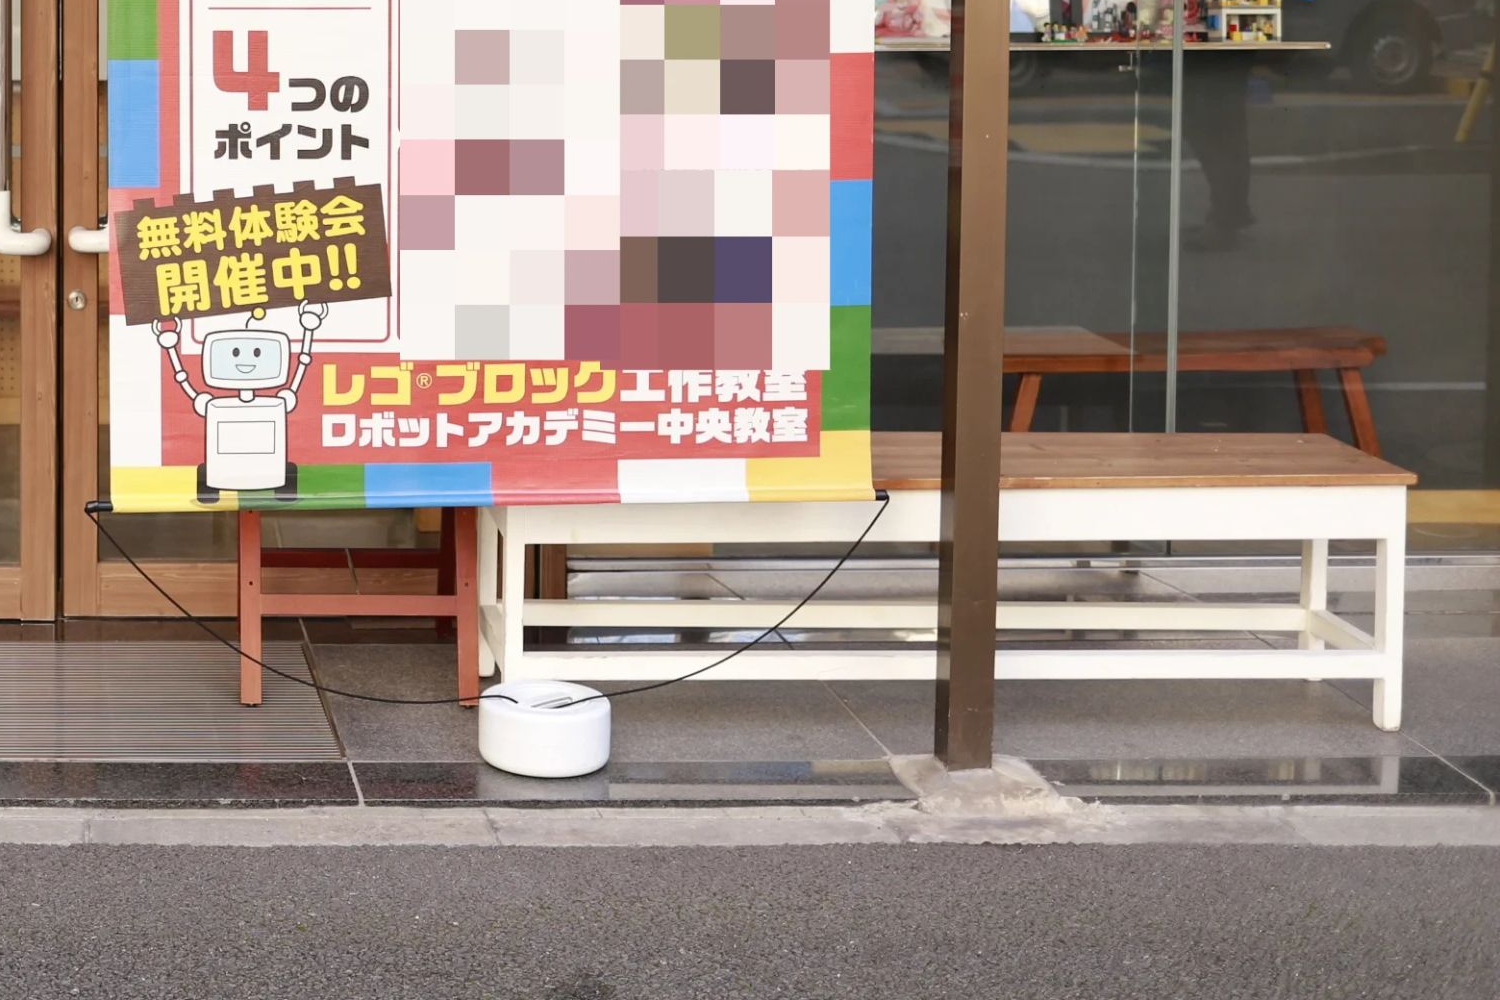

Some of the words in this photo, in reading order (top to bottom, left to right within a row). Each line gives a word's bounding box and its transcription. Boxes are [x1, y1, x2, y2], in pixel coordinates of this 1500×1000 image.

[212, 30, 370, 112] 4つの
[213, 122, 370, 161] ポイント
[136, 194, 367, 257] 無料体験会
[321, 406, 808, 449] ロボットアカデミー中央教室
